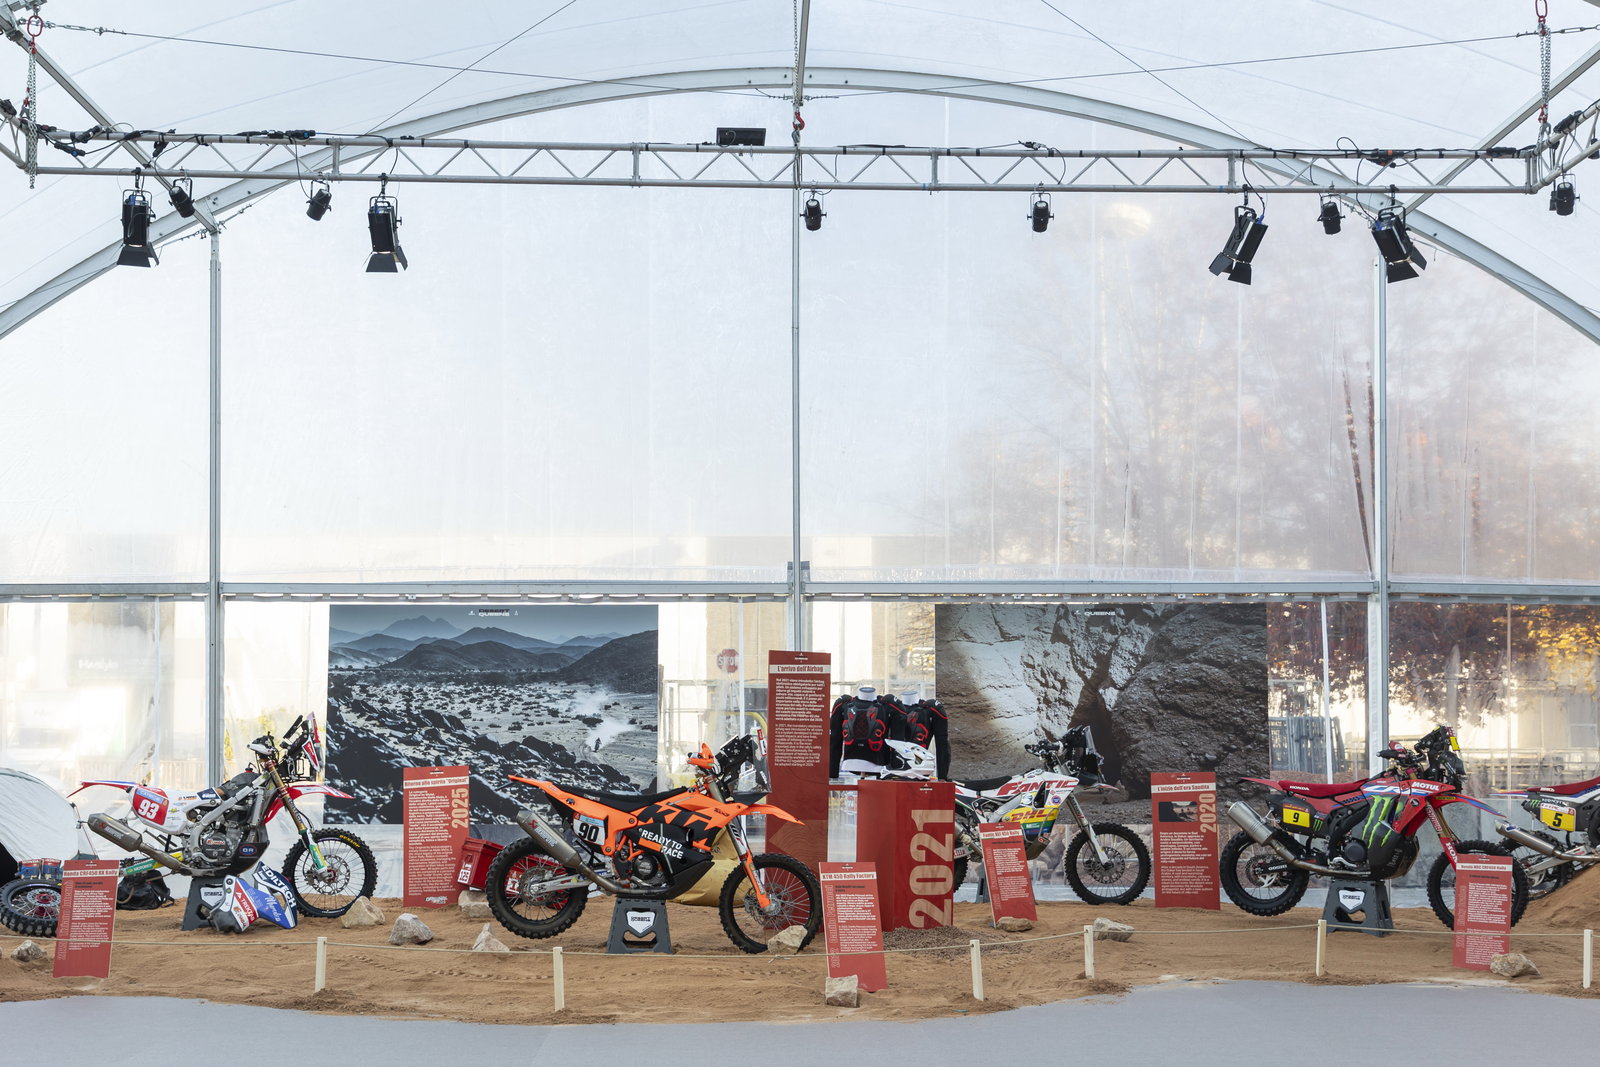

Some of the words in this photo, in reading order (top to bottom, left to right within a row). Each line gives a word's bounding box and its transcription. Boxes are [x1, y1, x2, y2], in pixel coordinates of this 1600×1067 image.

[996, 780, 1079, 796] FANTIC
[1412, 782, 1440, 791] MOTUL
[138, 799, 160, 820] 93
[451, 788, 468, 828] 2025
[1011, 809, 1047, 822] DHL
[1199, 793, 1216, 833] 2020
[1293, 812, 1300, 823] 9
[637, 804, 721, 848] KTM
[1552, 813, 1563, 827] 5
[579, 822, 599, 843] 90
[641, 829, 671, 848] READY
[671, 840, 682, 850] TO
[661, 846, 684, 859] RACE
[908, 809, 954, 928] 2021
[262, 865, 297, 908] EDILTECH
